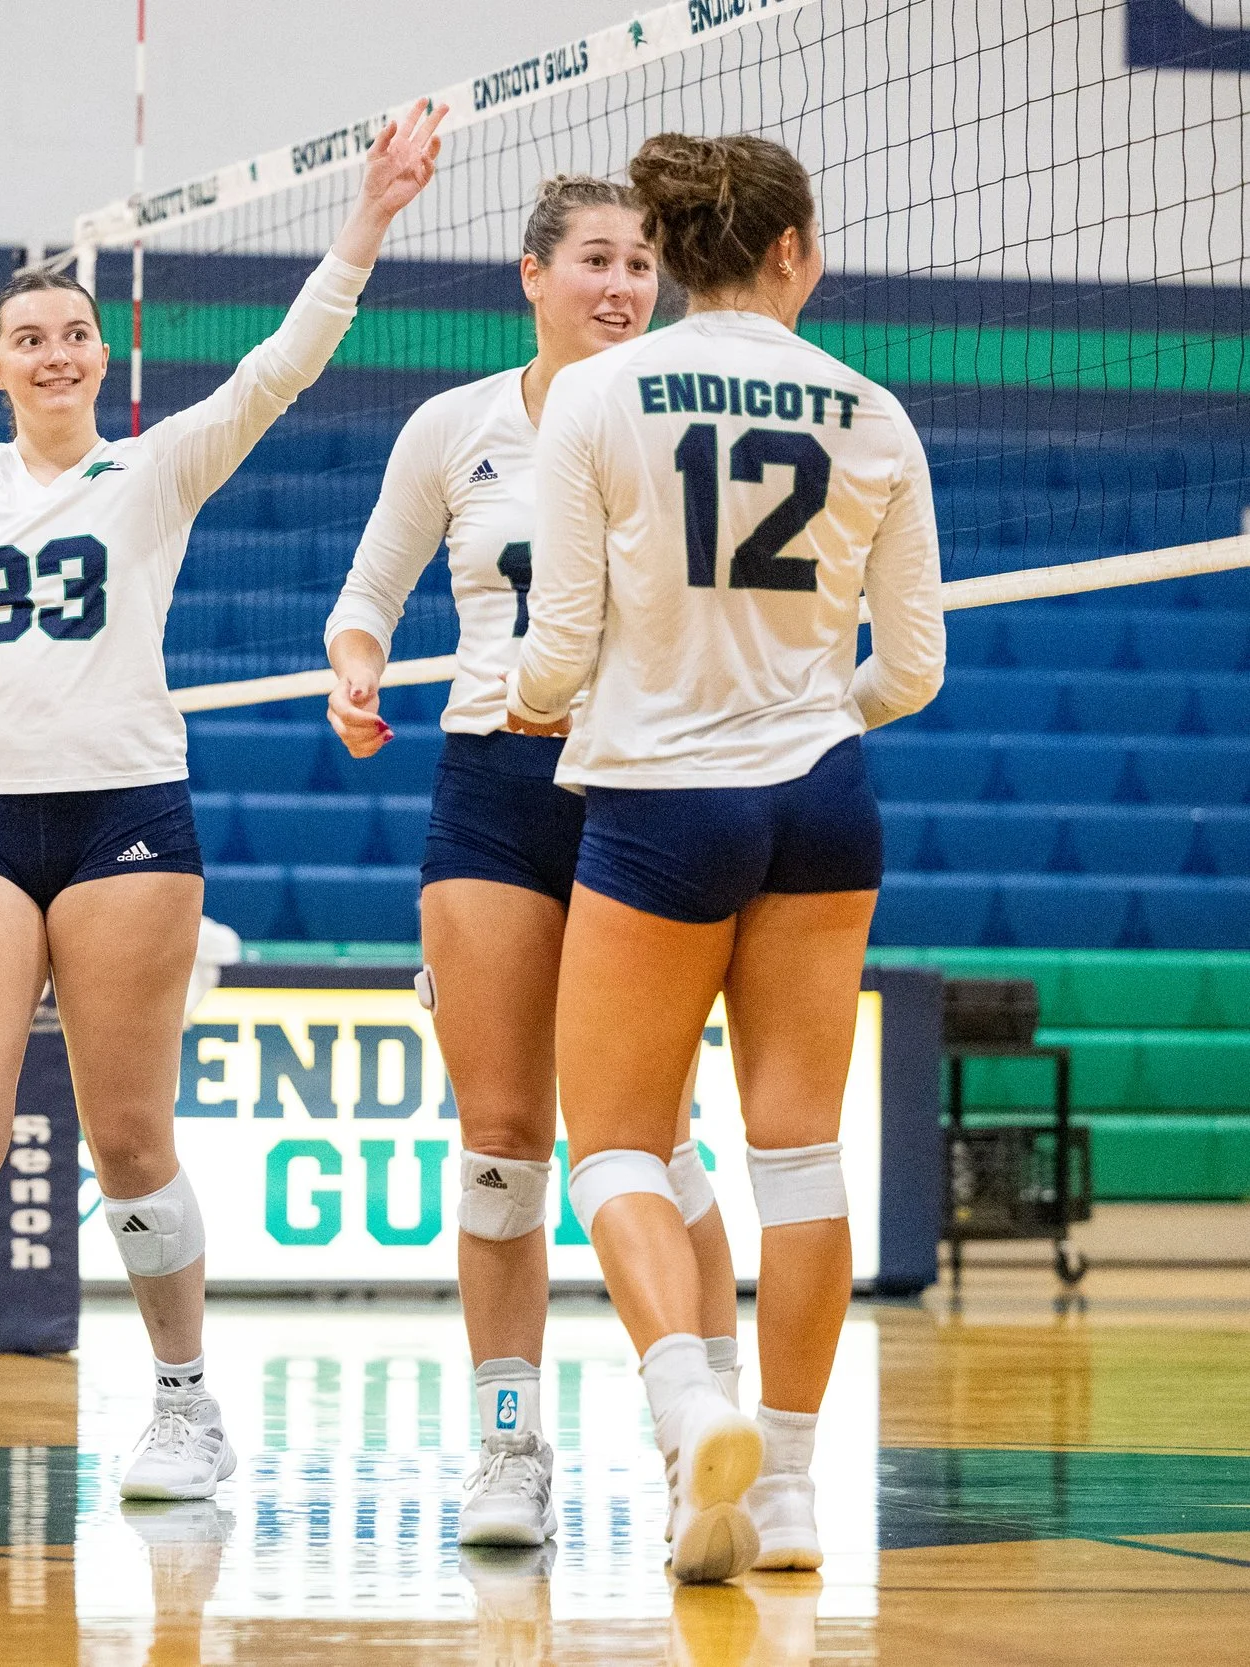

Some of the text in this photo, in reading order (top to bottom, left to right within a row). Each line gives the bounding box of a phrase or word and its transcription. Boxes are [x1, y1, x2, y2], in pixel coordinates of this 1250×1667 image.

[544, 40, 589, 84] GULLS
[637, 371, 859, 429] ENDICOTT
[674, 422, 832, 592] 12
[116, 852, 159, 862] adidas
[476, 1177, 508, 1190] adidas
